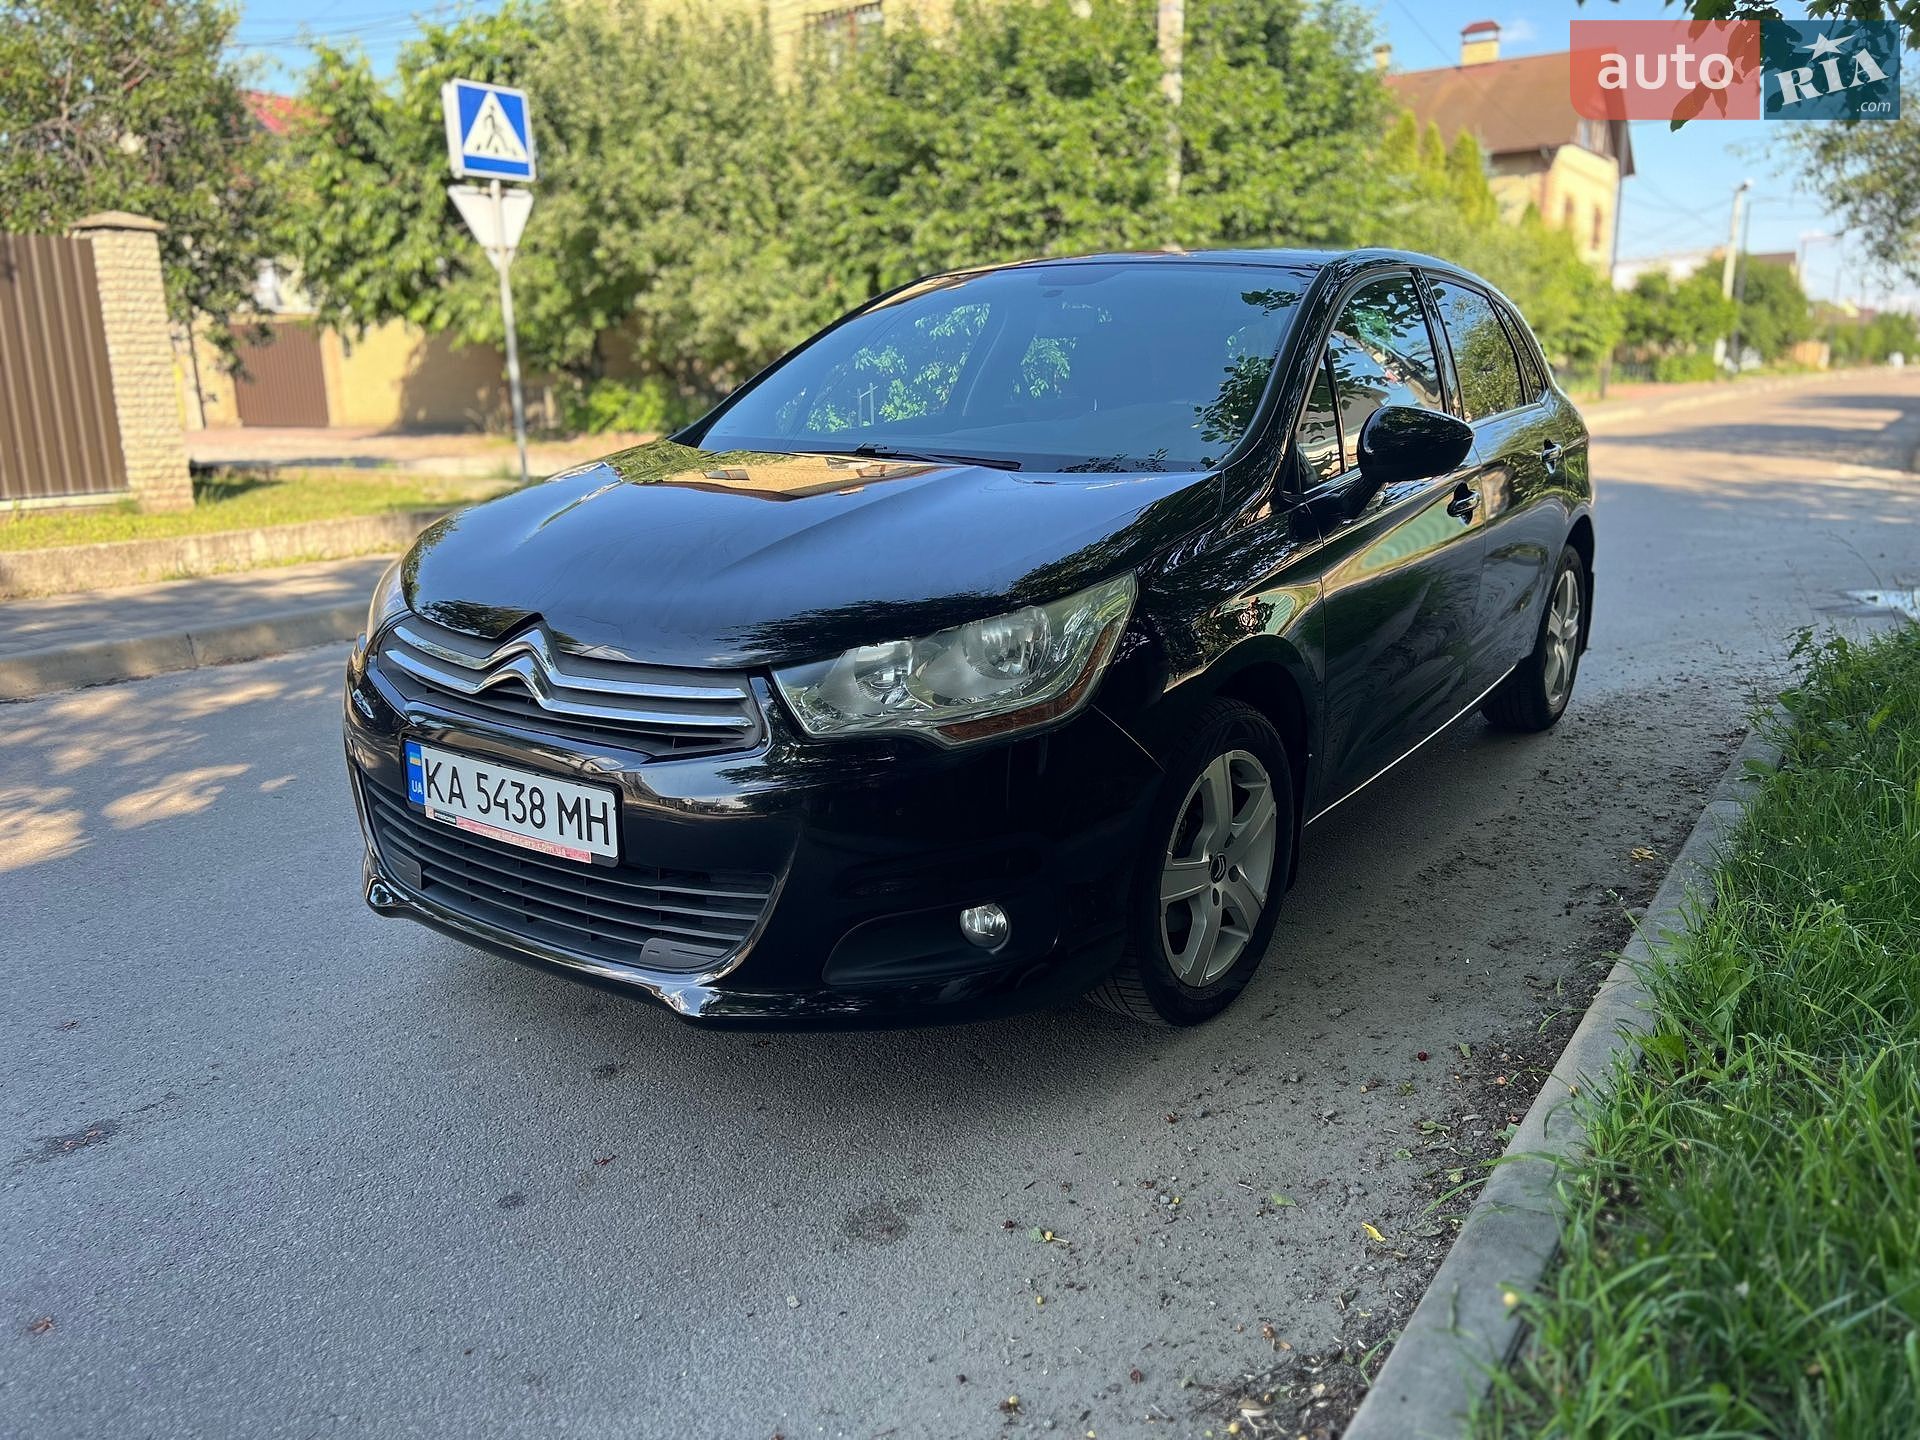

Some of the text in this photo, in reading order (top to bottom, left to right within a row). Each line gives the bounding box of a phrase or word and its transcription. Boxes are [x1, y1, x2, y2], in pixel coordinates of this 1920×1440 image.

[411, 780, 424, 795] UA
[425, 758, 610, 846] KA 5438 MH
